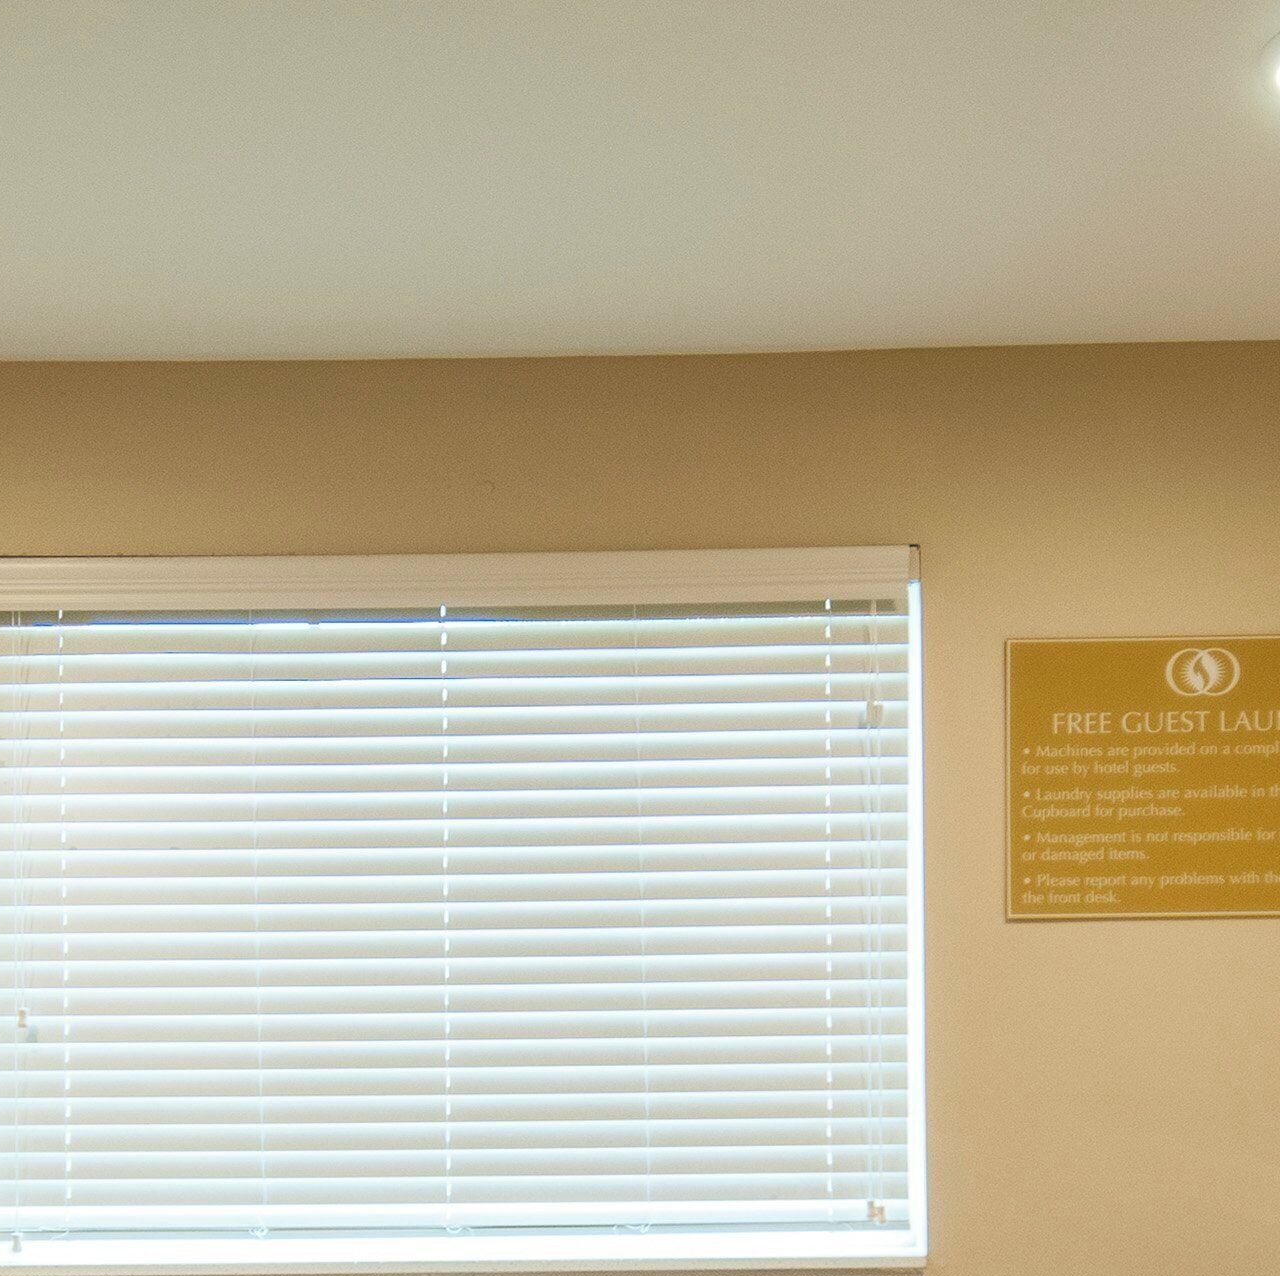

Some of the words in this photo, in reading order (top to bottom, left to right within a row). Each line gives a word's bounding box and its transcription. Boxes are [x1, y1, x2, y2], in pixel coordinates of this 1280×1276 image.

[1052, 712, 1112, 734] FREE
[1121, 710, 1210, 734] GUEST
[1035, 744, 1103, 758] Machines
[1107, 747, 1130, 757] are
[1133, 743, 1196, 759] provided
[1199, 745, 1218, 755] on
[1223, 746, 1231, 754] a
[1021, 761, 1040, 775] for
[1045, 764, 1069, 775] use
[1072, 761, 1089, 777] by
[1094, 761, 1129, 774] hotel
[1133, 762, 1180, 777] guests.
[1036, 787, 1093, 802] Laundry
[1097, 786, 1154, 803] supplies
[1158, 788, 1180, 799] are
[1184, 784, 1248, 799] available
[1252, 784, 1266, 797] in
[1022, 804, 1091, 821] Cupboard
[1095, 804, 1114, 818] for
[1118, 803, 1185, 821] purchase.
[1036, 831, 1126, 846] Management
[1131, 830, 1141, 842] is
[1146, 831, 1168, 842] not
[1173, 827, 1252, 845] responsible
[1256, 827, 1277, 841] for
[1022, 851, 1036, 861] or
[1041, 847, 1105, 863] damaged
[1108, 847, 1150, 860] items.
[1036, 873, 1081, 886] Please
[1084, 875, 1126, 889] report
[1131, 875, 1155, 889] any
[1159, 872, 1226, 889] problems
[1229, 871, 1260, 884] with
[1021, 891, 1044, 904] the
[1047, 890, 1081, 904] front
